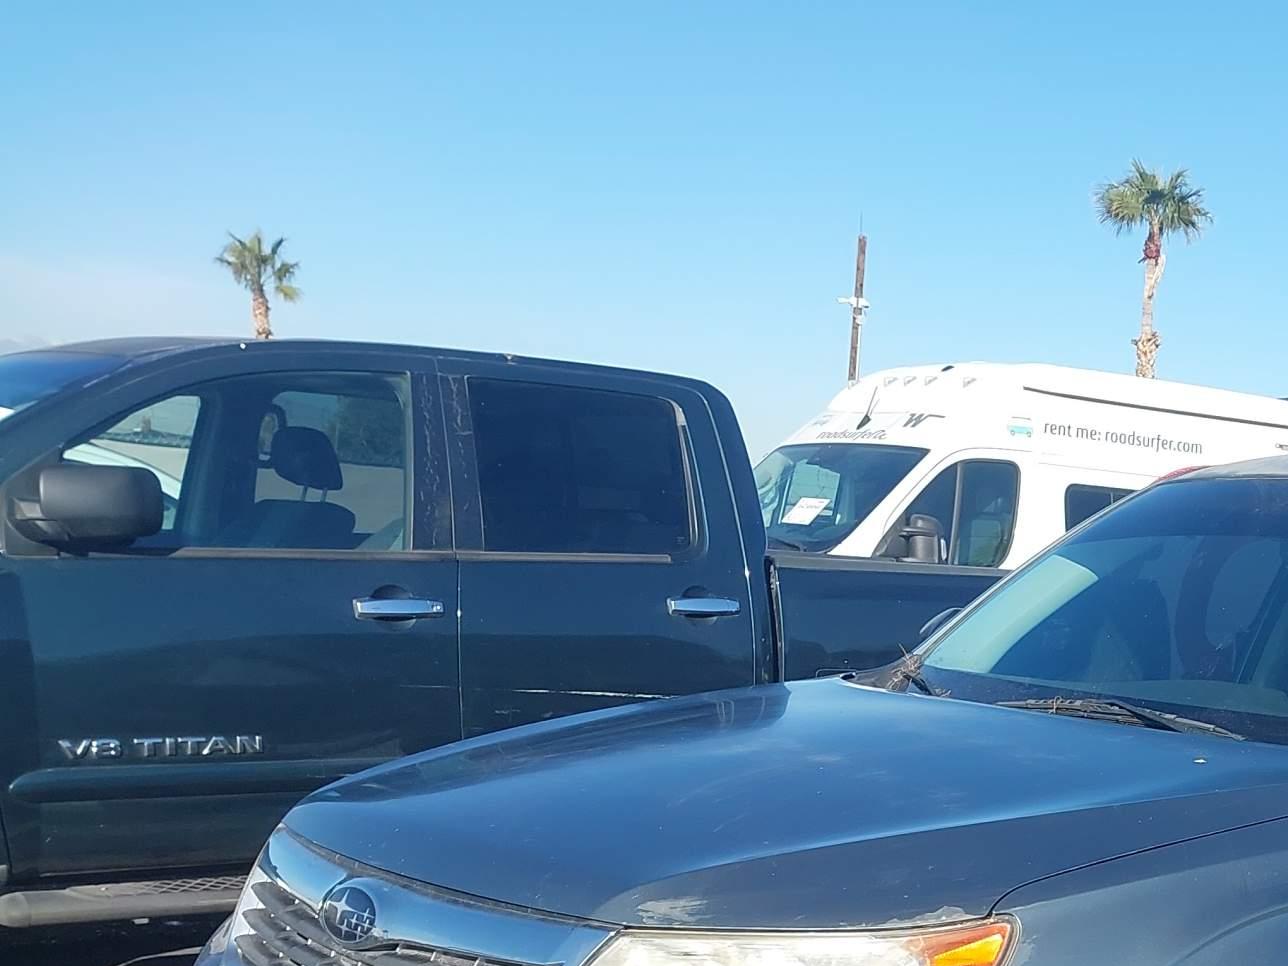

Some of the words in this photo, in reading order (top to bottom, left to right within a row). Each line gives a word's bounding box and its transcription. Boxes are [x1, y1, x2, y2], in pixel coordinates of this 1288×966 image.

[1044, 422, 1072, 438] rent
[1076, 427, 1101, 441] me:
[1105, 430, 1203, 454] roadsurfer.com
[58, 738, 123, 760] V8
[133, 735, 264, 757] TITAN
